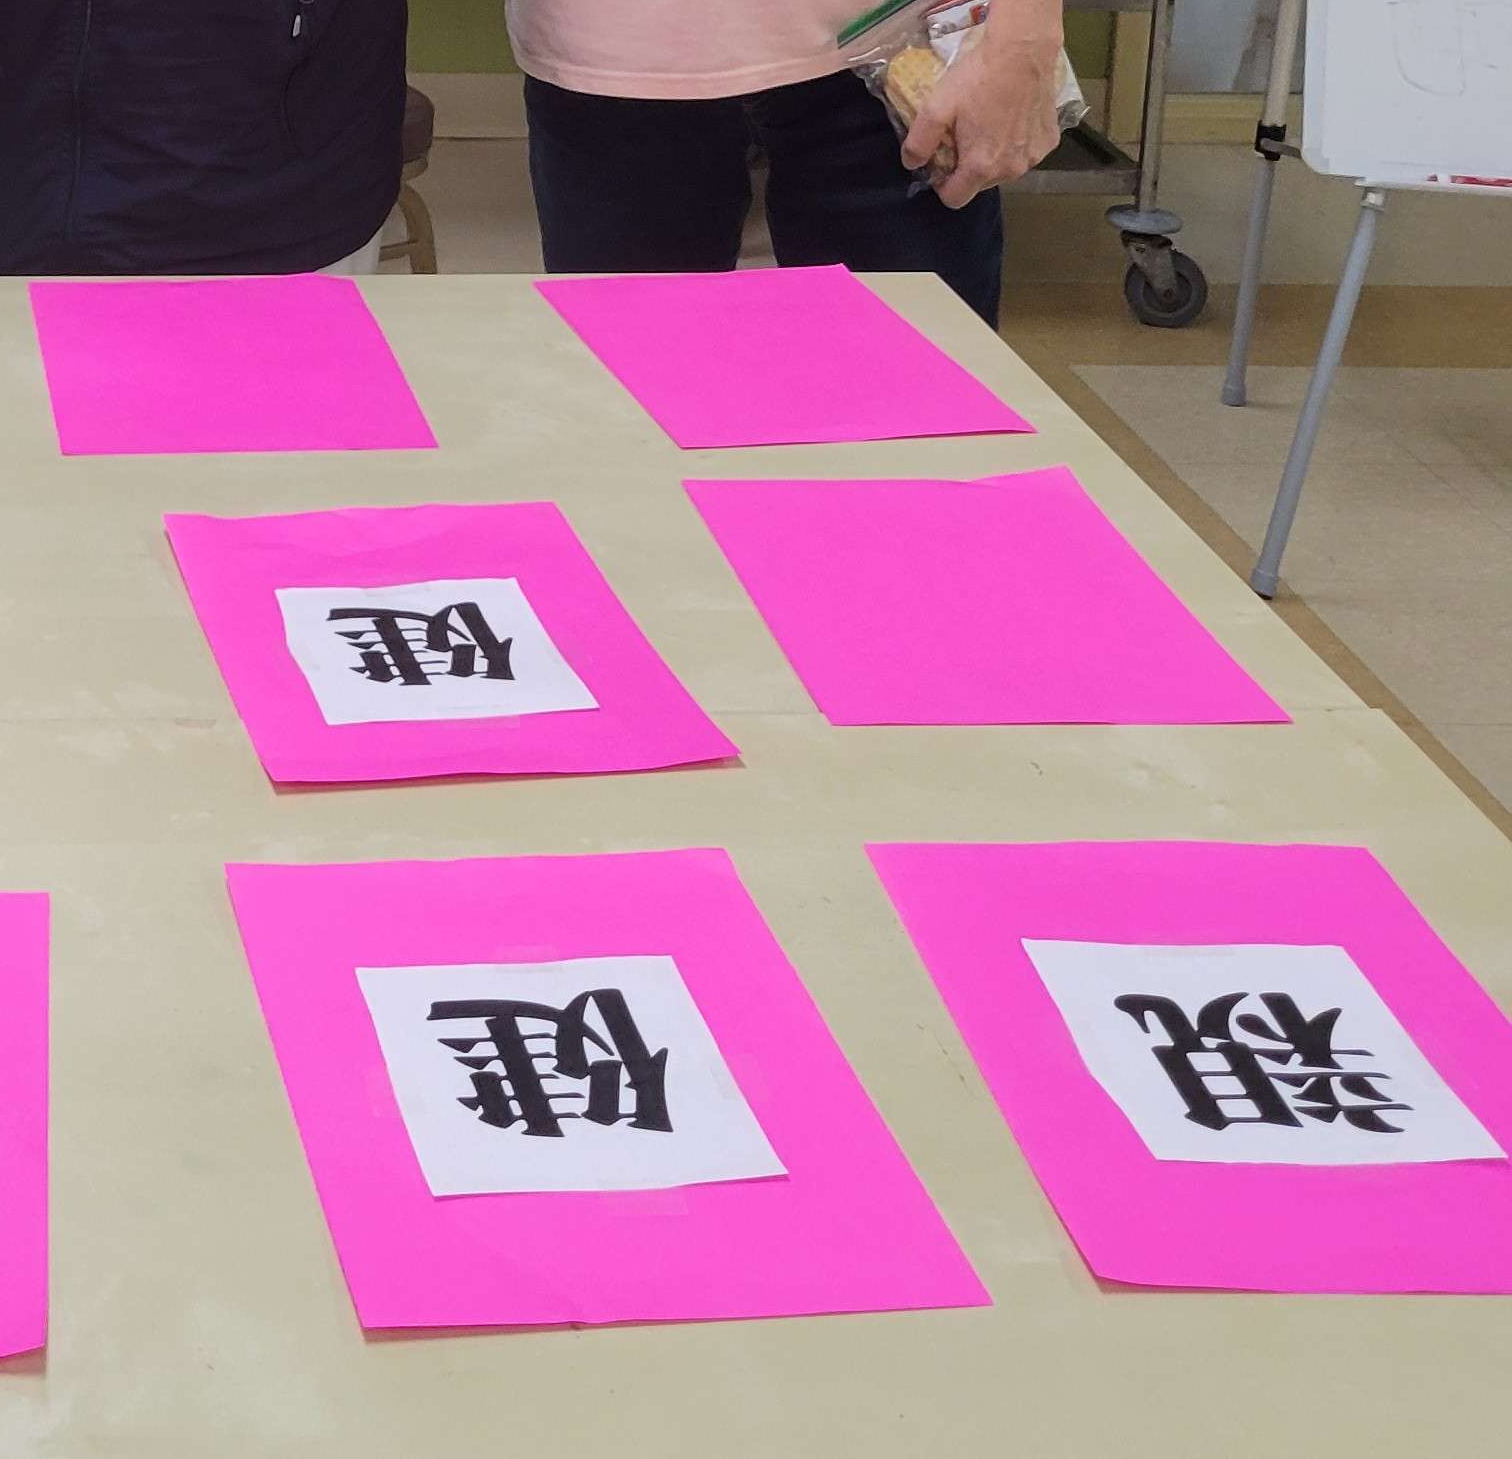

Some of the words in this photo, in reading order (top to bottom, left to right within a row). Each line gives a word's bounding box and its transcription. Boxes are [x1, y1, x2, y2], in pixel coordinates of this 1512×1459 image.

[326, 601, 516, 686] 健
[426, 988, 674, 1138] 健
[1113, 992, 1415, 1134] 親
